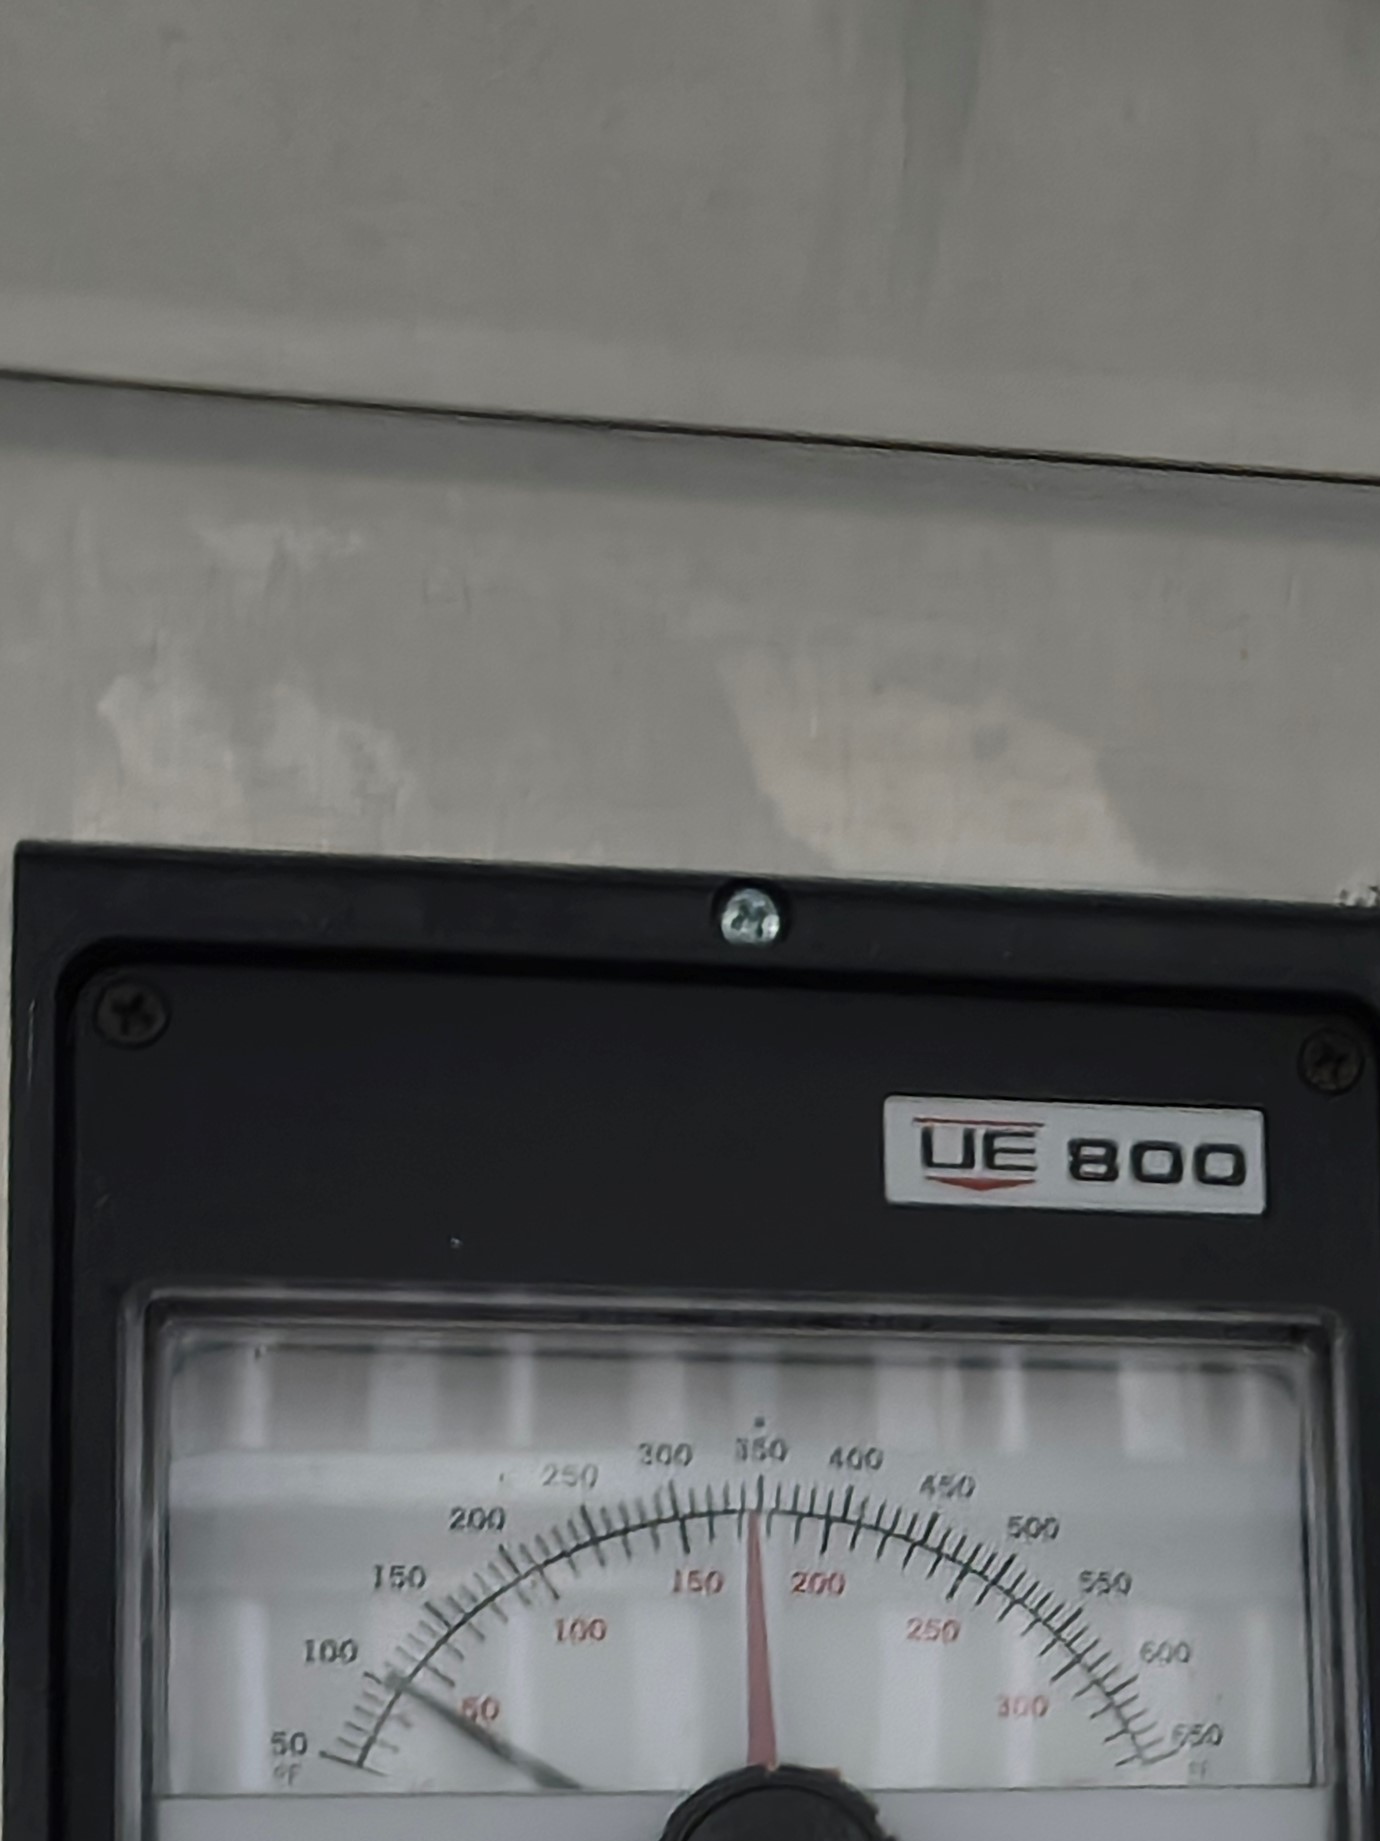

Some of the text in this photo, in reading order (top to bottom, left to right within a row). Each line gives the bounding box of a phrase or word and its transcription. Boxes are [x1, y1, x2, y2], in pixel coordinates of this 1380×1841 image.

[1068, 1138, 1246, 1187] 800
[639, 1443, 693, 1467] 300
[829, 1447, 883, 1471] 400
[542, 1465, 598, 1488] 250
[920, 1474, 974, 1500] 450
[449, 1506, 506, 1532] 200
[1007, 1516, 1059, 1540] 500
[373, 1565, 426, 1590] 150
[672, 1570, 723, 1594] 150
[791, 1571, 846, 1595] 200
[1078, 1571, 1132, 1597] 550
[555, 1618, 607, 1642] 100
[907, 1619, 959, 1643] 250
[304, 1639, 358, 1664] 100
[1140, 1641, 1192, 1665] 600
[271, 1732, 308, 1757] 50
